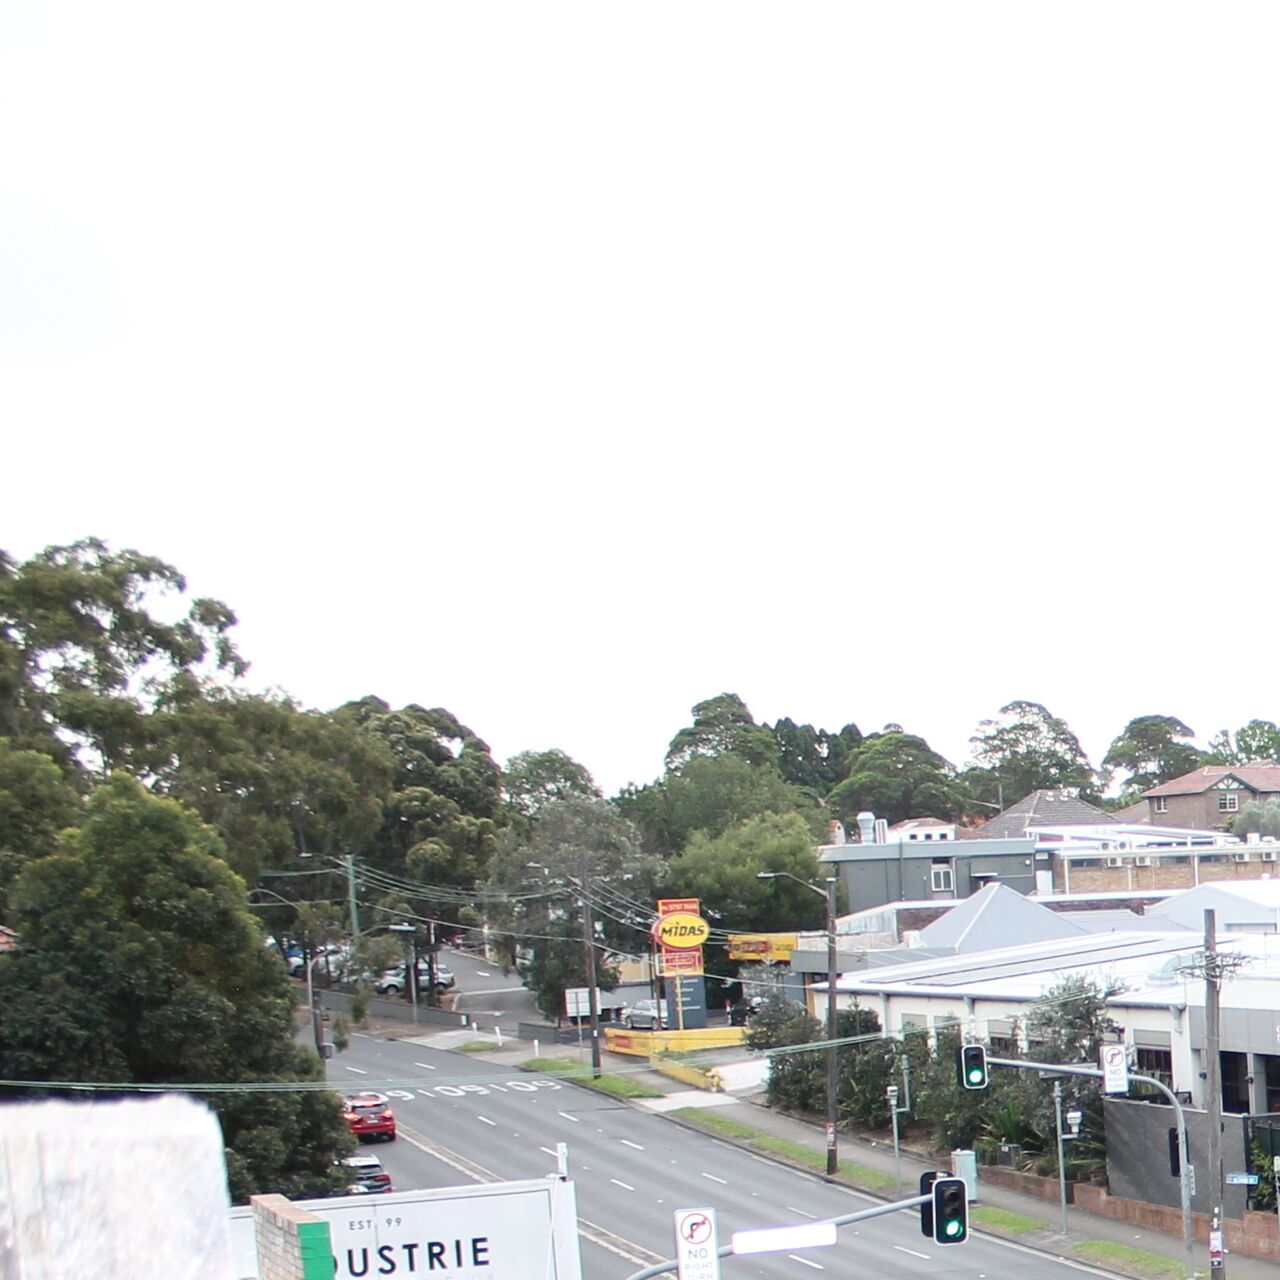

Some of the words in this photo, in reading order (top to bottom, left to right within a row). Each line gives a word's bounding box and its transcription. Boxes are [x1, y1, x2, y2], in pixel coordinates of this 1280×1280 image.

[661, 922, 705, 938] MIDAS
[386, 1217, 401, 1228] 99
[333, 1236, 490, 1277] USTRIE
[688, 1247, 708, 1260] NO
